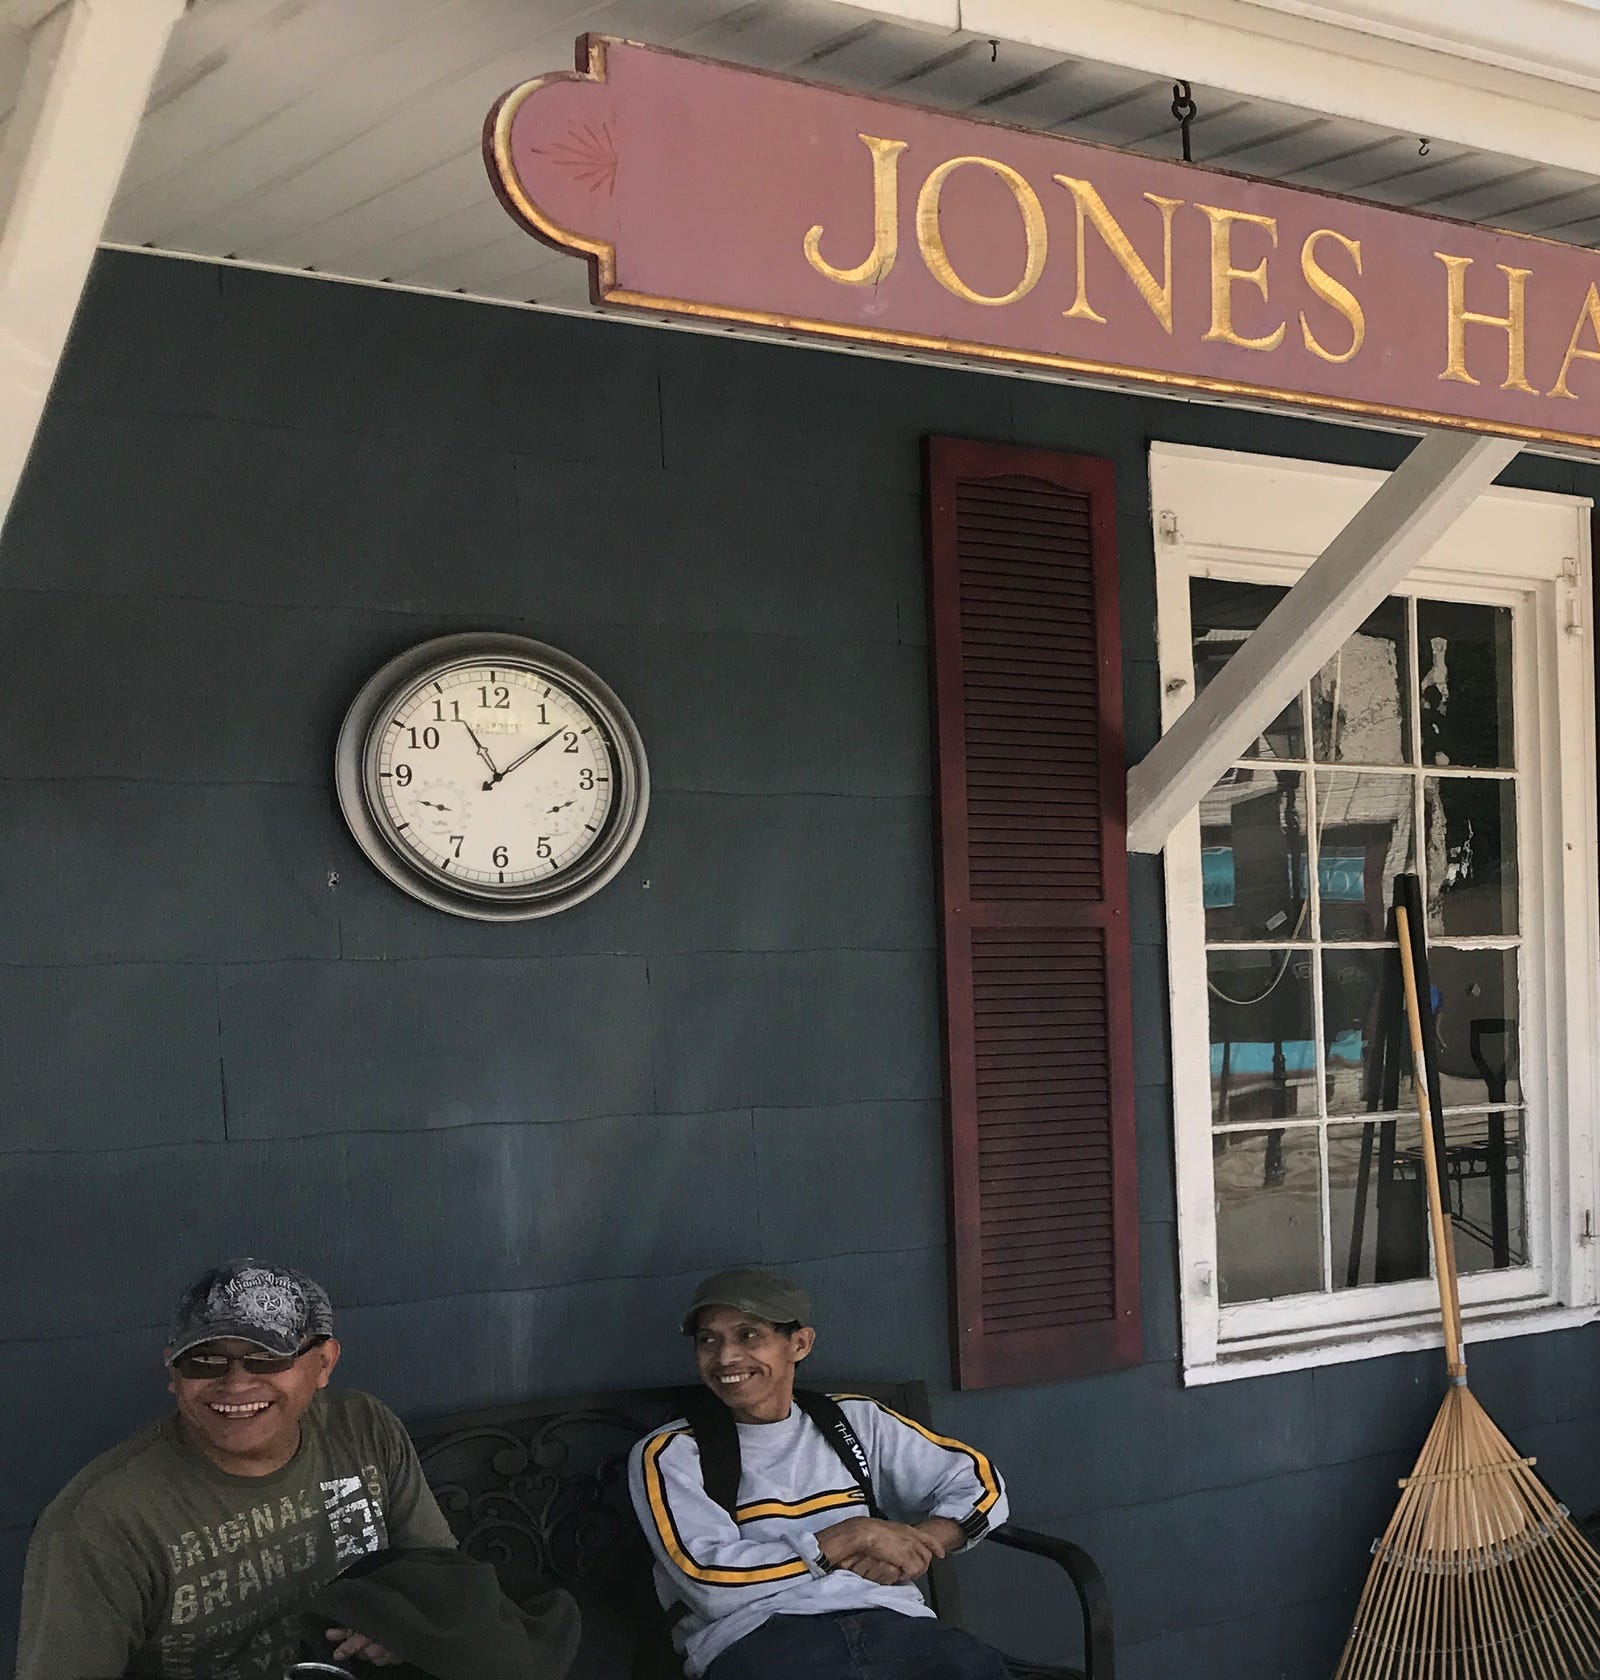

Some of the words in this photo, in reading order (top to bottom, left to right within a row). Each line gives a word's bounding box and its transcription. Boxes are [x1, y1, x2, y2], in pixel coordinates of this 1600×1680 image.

[804, 133, 1367, 365] JONES
[477, 686, 511, 709] 12
[432, 700, 462, 722] 11
[537, 704, 551, 725] 1
[407, 727, 440, 750] 10
[563, 732, 579, 754] 2
[395, 765, 413, 787] 9
[579, 769, 595, 791] 3
[449, 836, 464, 858] 7
[492, 846, 509, 868] 6
[536, 837, 552, 858] 5
[834, 1421, 856, 1446] THE
[851, 1444, 870, 1478] WIZ
[171, 1533, 318, 1626] BRAND
